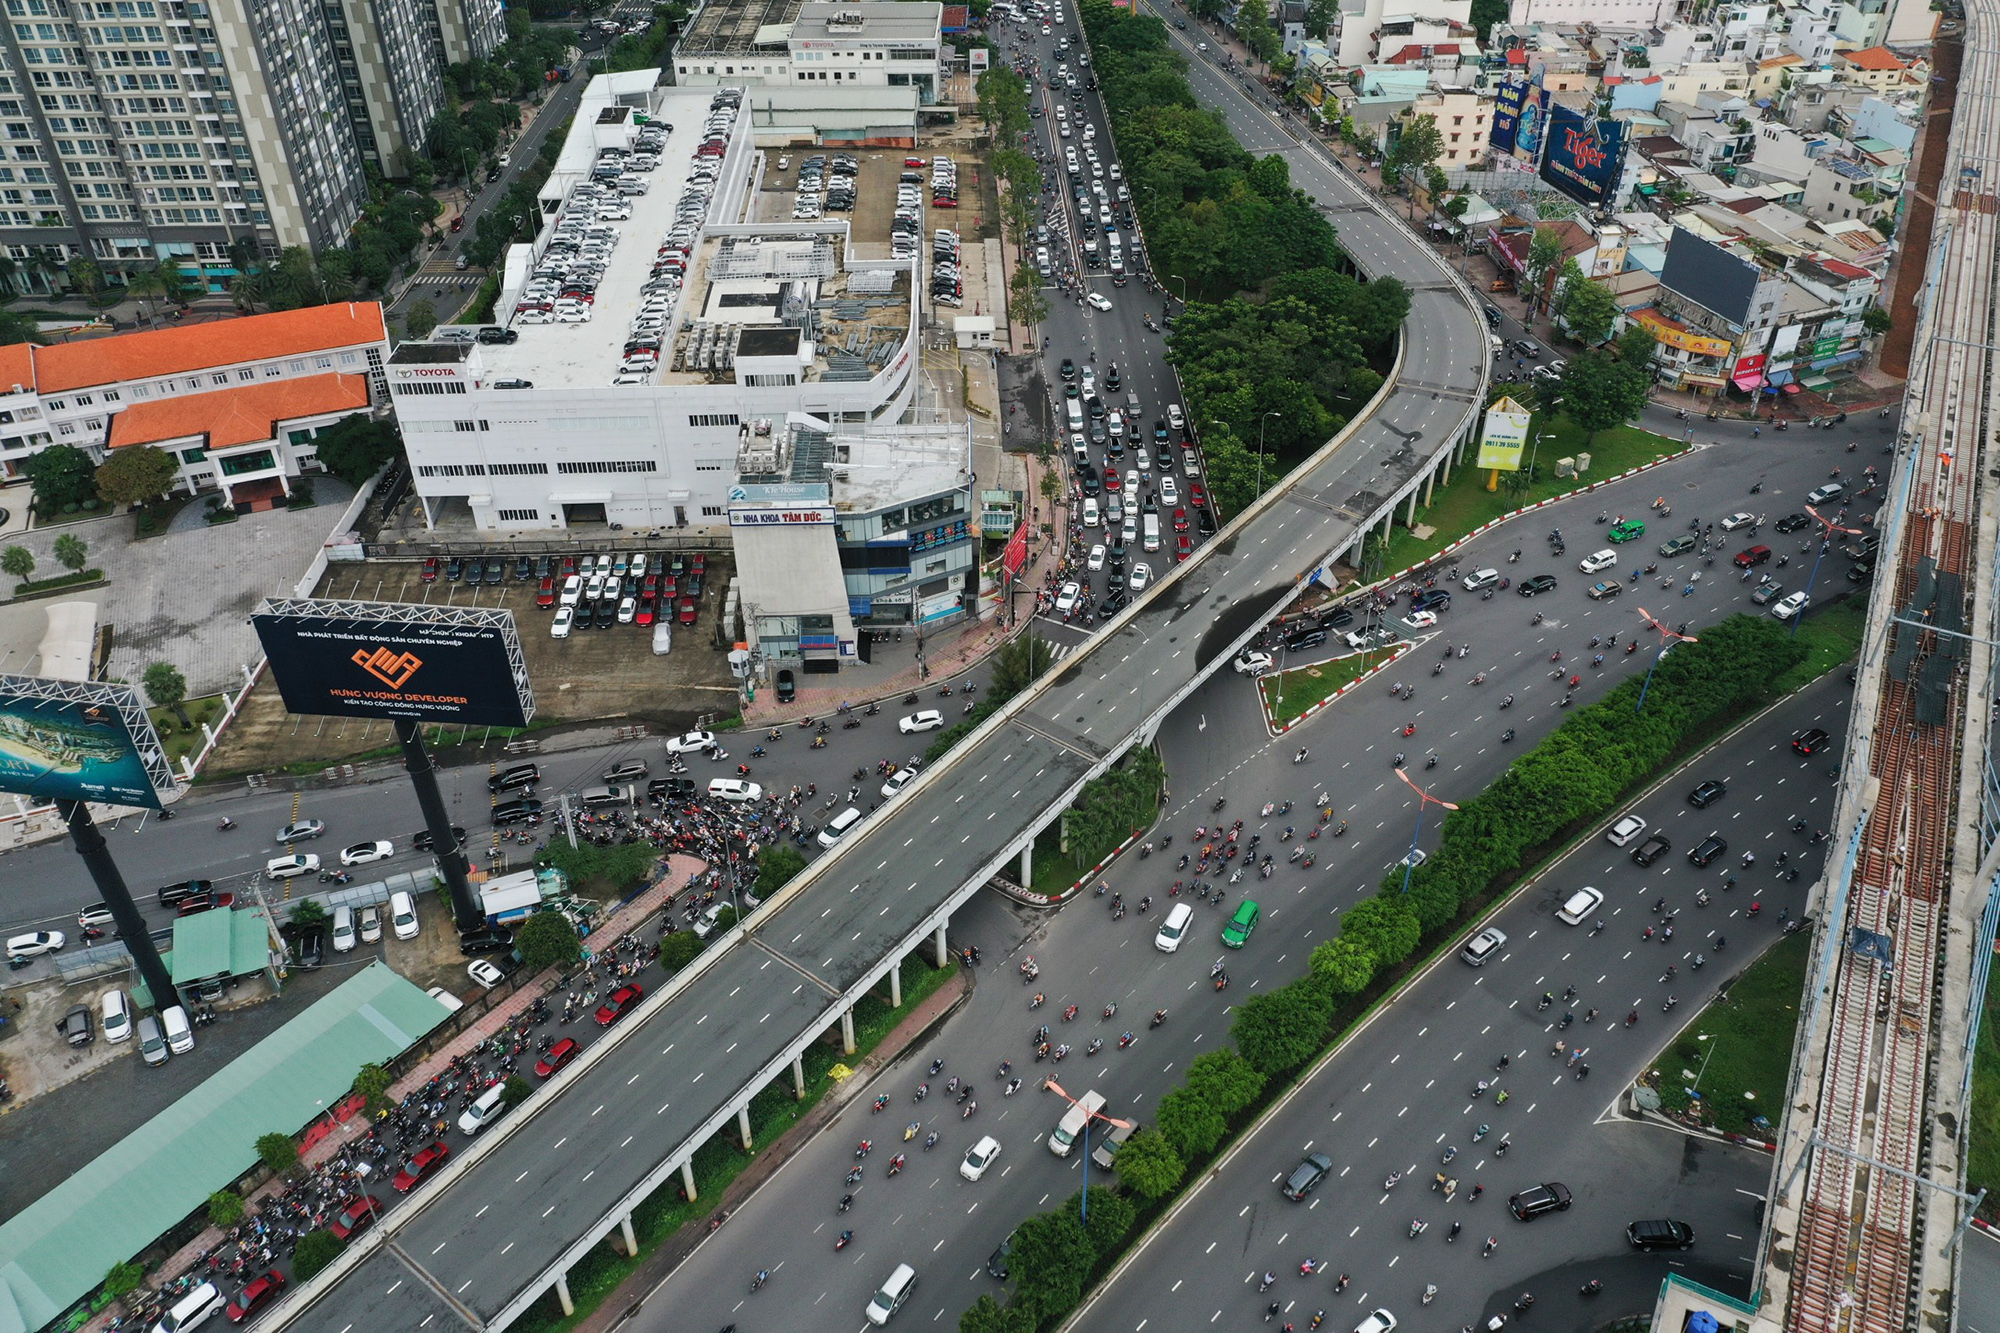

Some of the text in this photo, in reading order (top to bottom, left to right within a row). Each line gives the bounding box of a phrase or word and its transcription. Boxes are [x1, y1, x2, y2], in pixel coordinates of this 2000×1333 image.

[1502, 88, 1519, 102] NĂM
[1496, 102, 1519, 118] MÃNH
[1563, 127, 1607, 169] Tiger
[91, 226, 145, 235] ANDMARK
[413, 368, 456, 377] TOYOTA
[743, 514, 759, 523] NHA
[760, 514, 780, 523] KHOA
[782, 512, 802, 522] TÂM
[803, 511, 822, 522] ĐỨC
[406, 637, 436, 645] CHUYÊN
[329, 688, 468, 704] HƯNG VƯỢNG DEVELOPER
[374, 700, 394, 708] CỘNG
